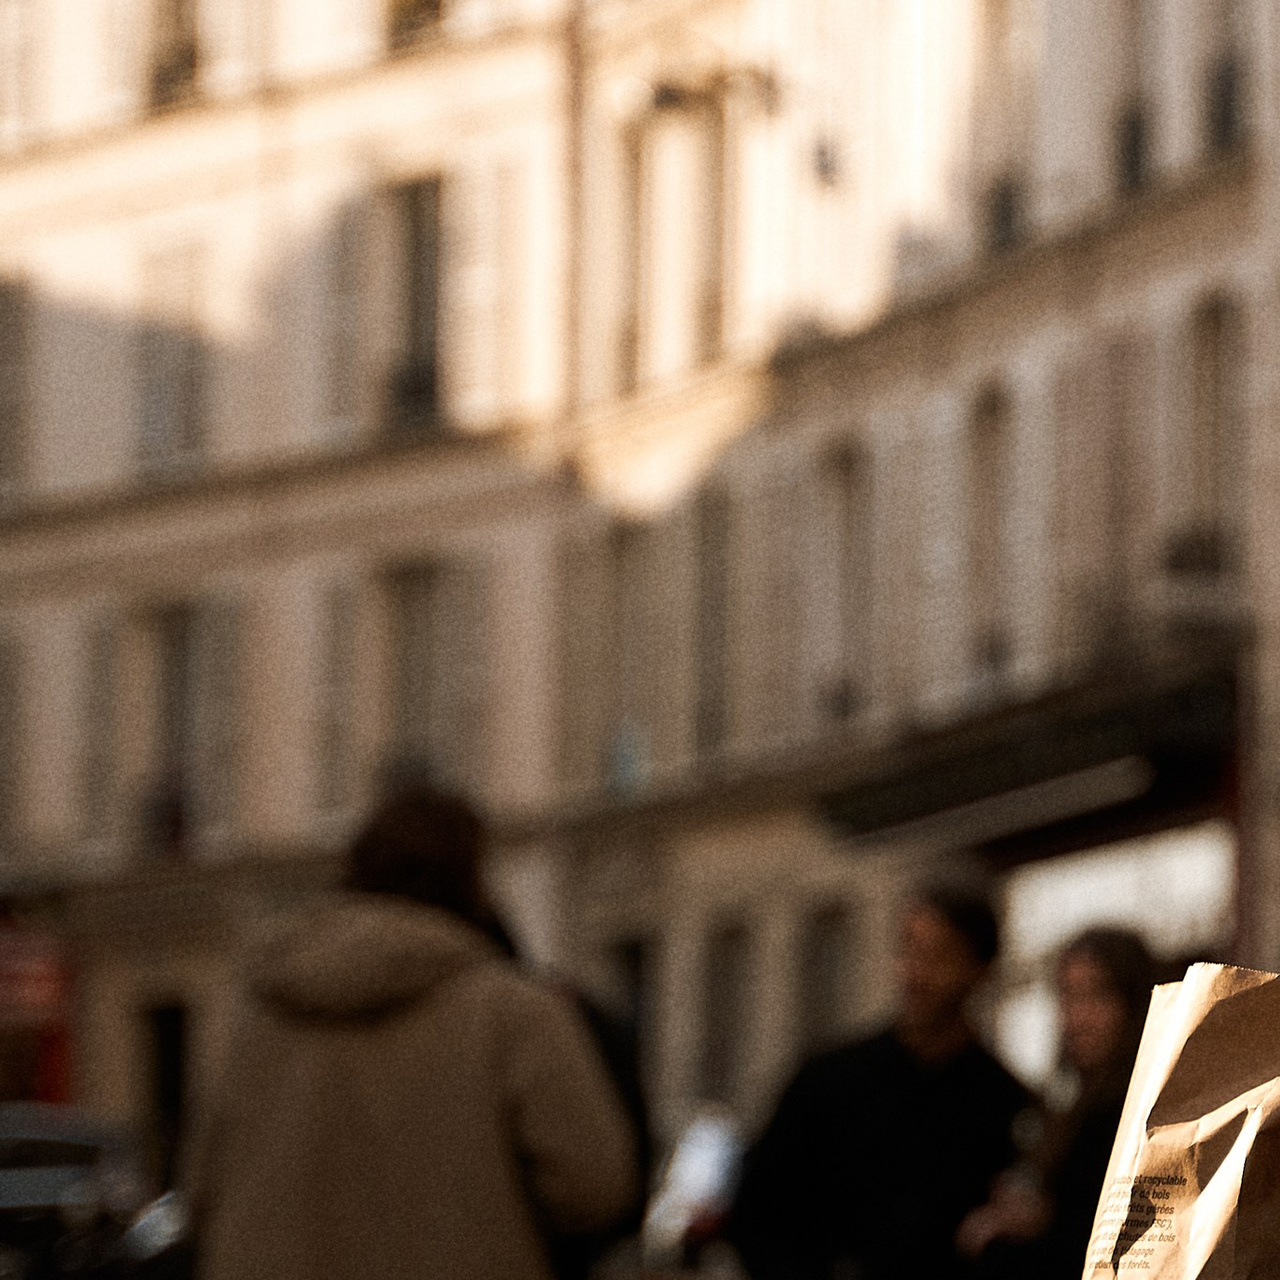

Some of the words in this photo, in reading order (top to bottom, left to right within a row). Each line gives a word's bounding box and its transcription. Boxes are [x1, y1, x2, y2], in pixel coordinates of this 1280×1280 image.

[1144, 1175, 1188, 1187] recyclable
[1152, 1189, 1171, 1200] bois
[1158, 1233, 1176, 1242] bois
